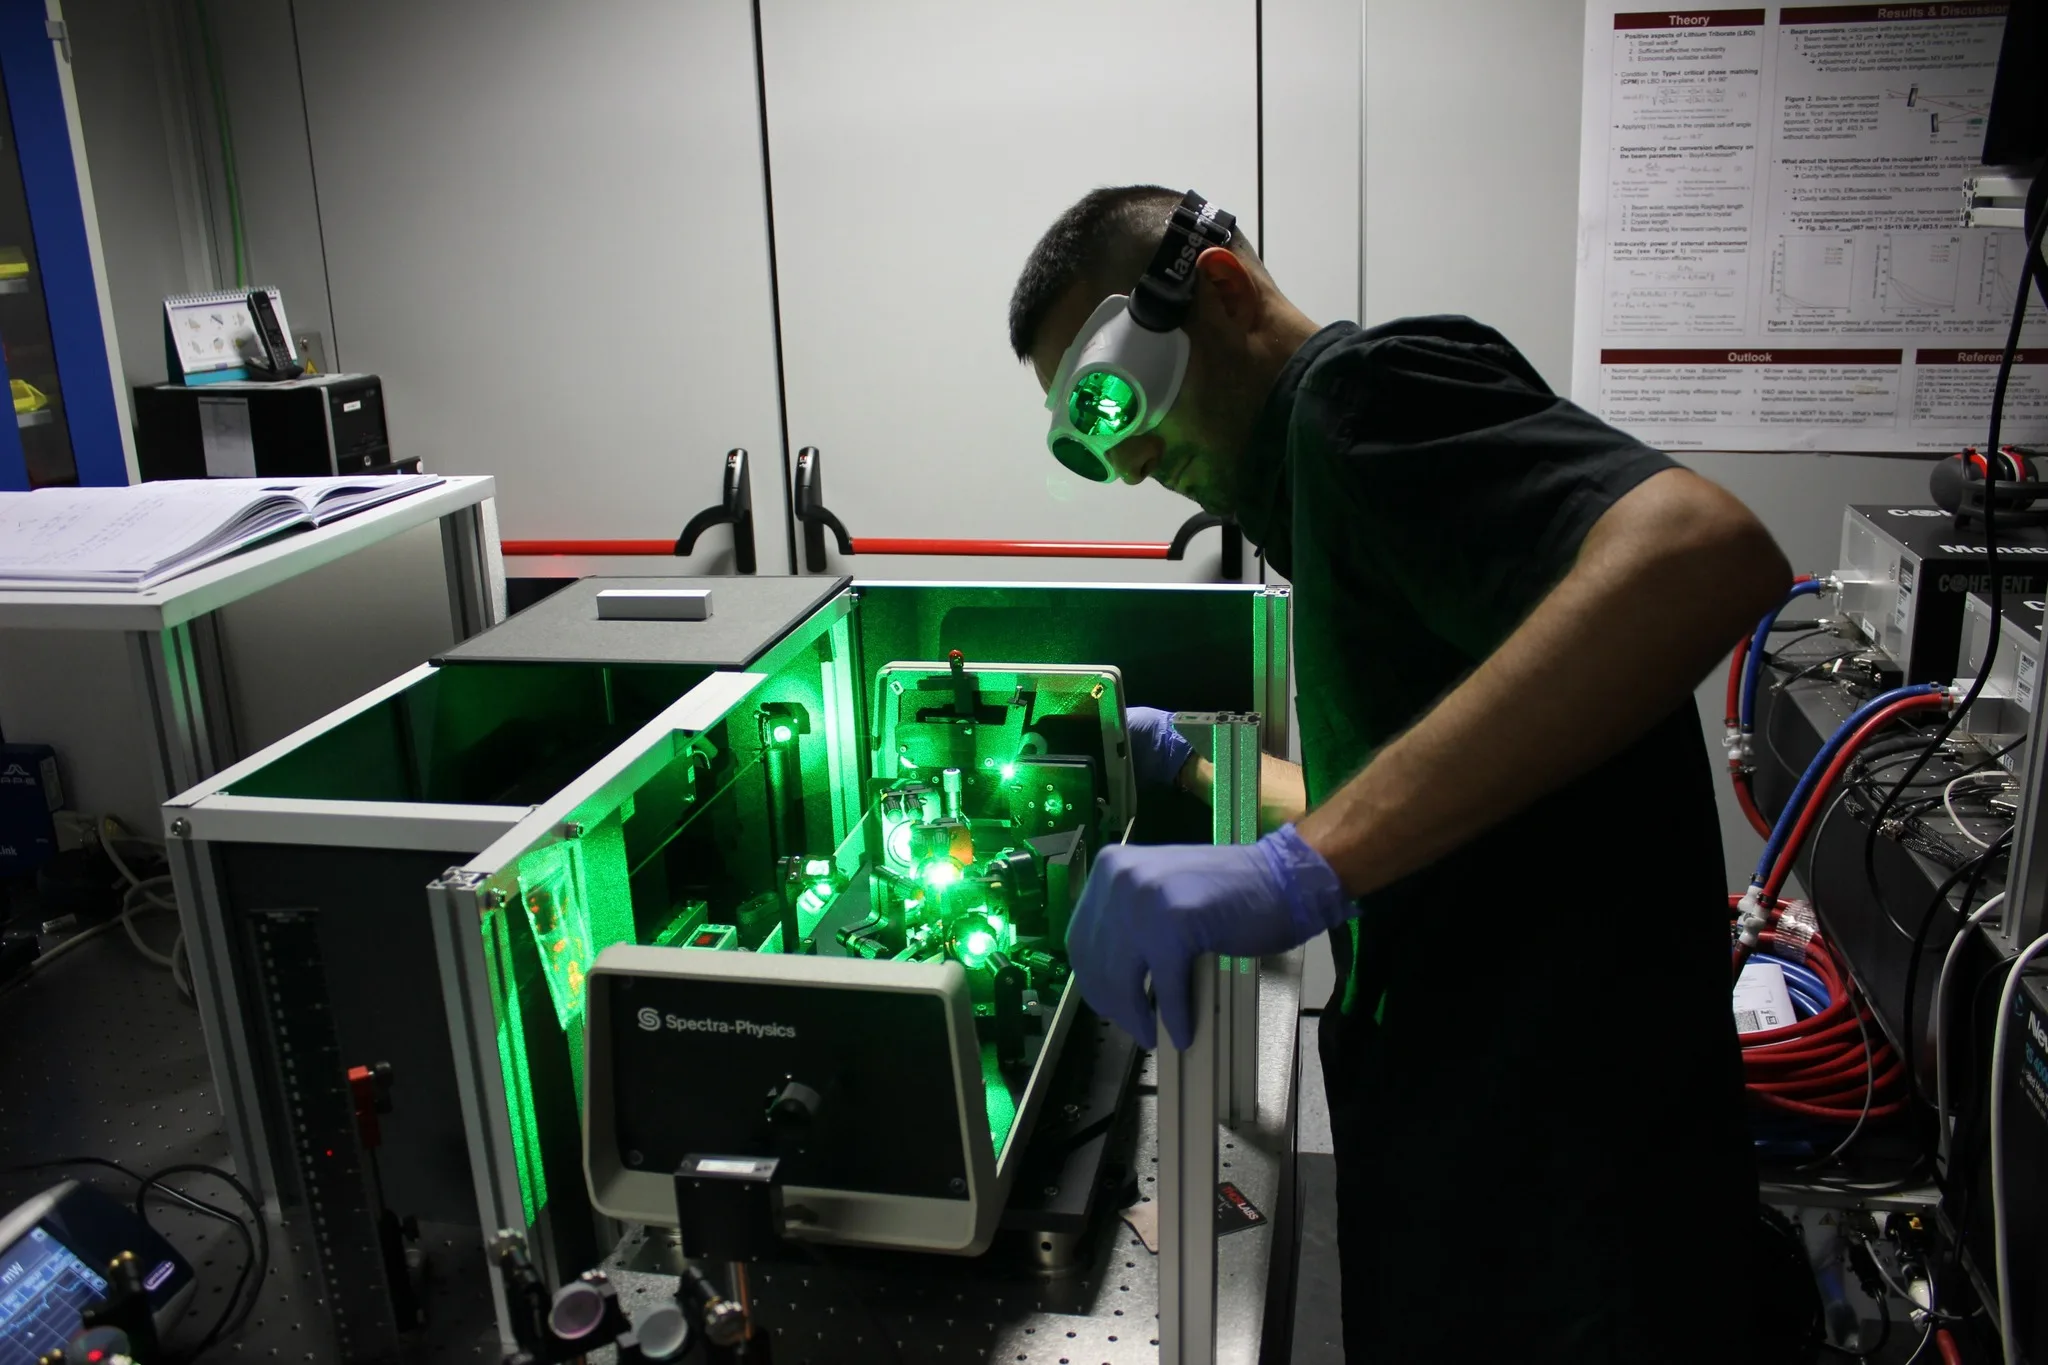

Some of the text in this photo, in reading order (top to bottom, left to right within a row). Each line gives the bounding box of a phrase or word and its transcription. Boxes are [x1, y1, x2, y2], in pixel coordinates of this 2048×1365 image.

[1878, 4, 2009, 19] Results & Discussion
[1669, 15, 1710, 27] Theory
[1728, 352, 1772, 362] Outlook
[1957, 352, 2024, 362] Referens
[1939, 574, 2033, 593] COHEENT
[665, 1014, 796, 1039] Spectra-Physics
[2, 1261, 25, 1284] mW
